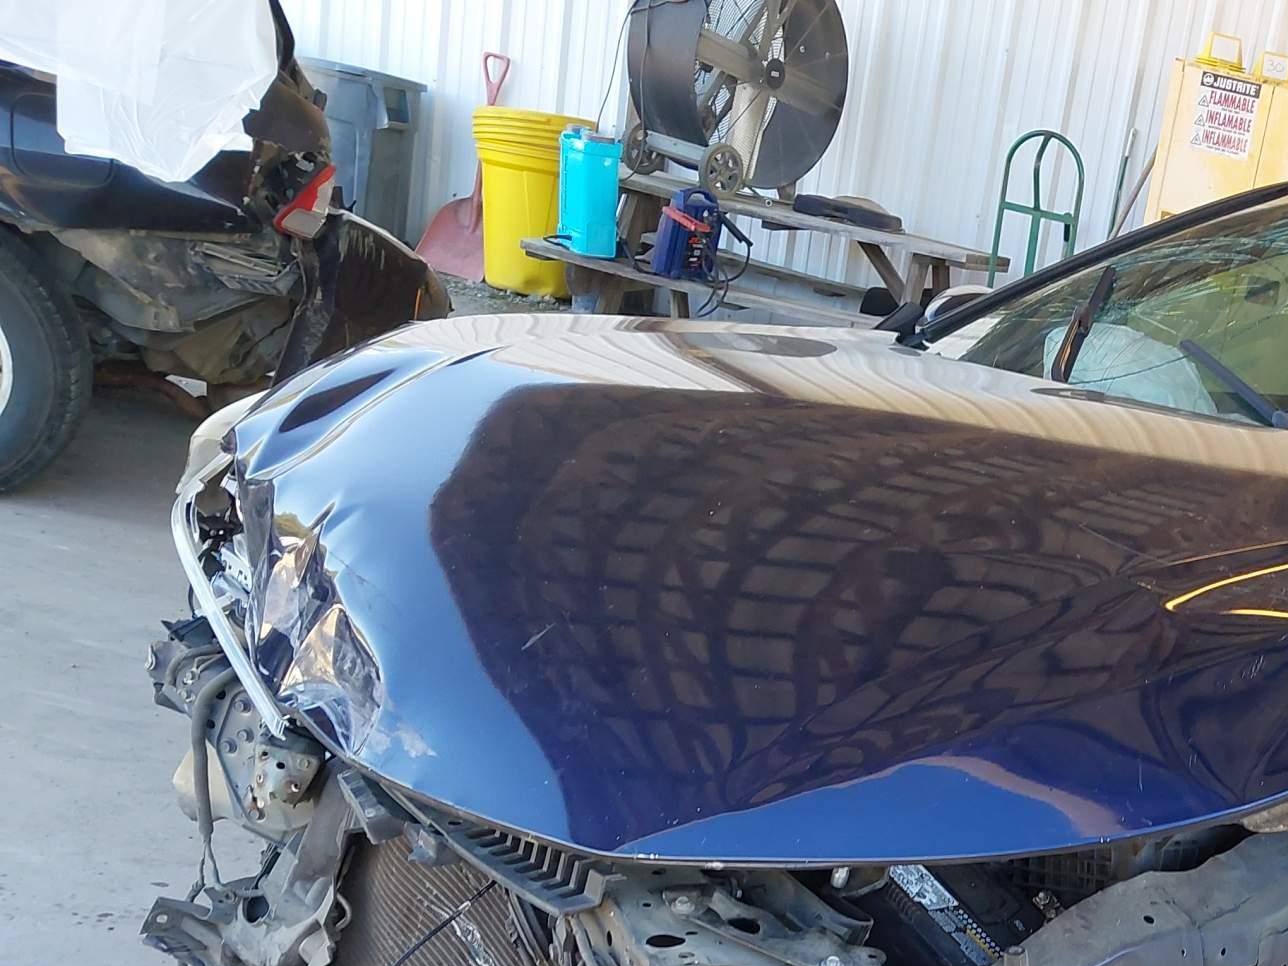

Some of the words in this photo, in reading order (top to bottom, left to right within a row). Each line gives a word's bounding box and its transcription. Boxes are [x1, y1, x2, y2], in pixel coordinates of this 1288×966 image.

[1213, 76, 1257, 95] JUSTRITE
[1209, 90, 1256, 114] FLAMMABLE
[1205, 109, 1252, 133] INFLAMABLE
[1201, 128, 1248, 153] INFLAMMABLE
